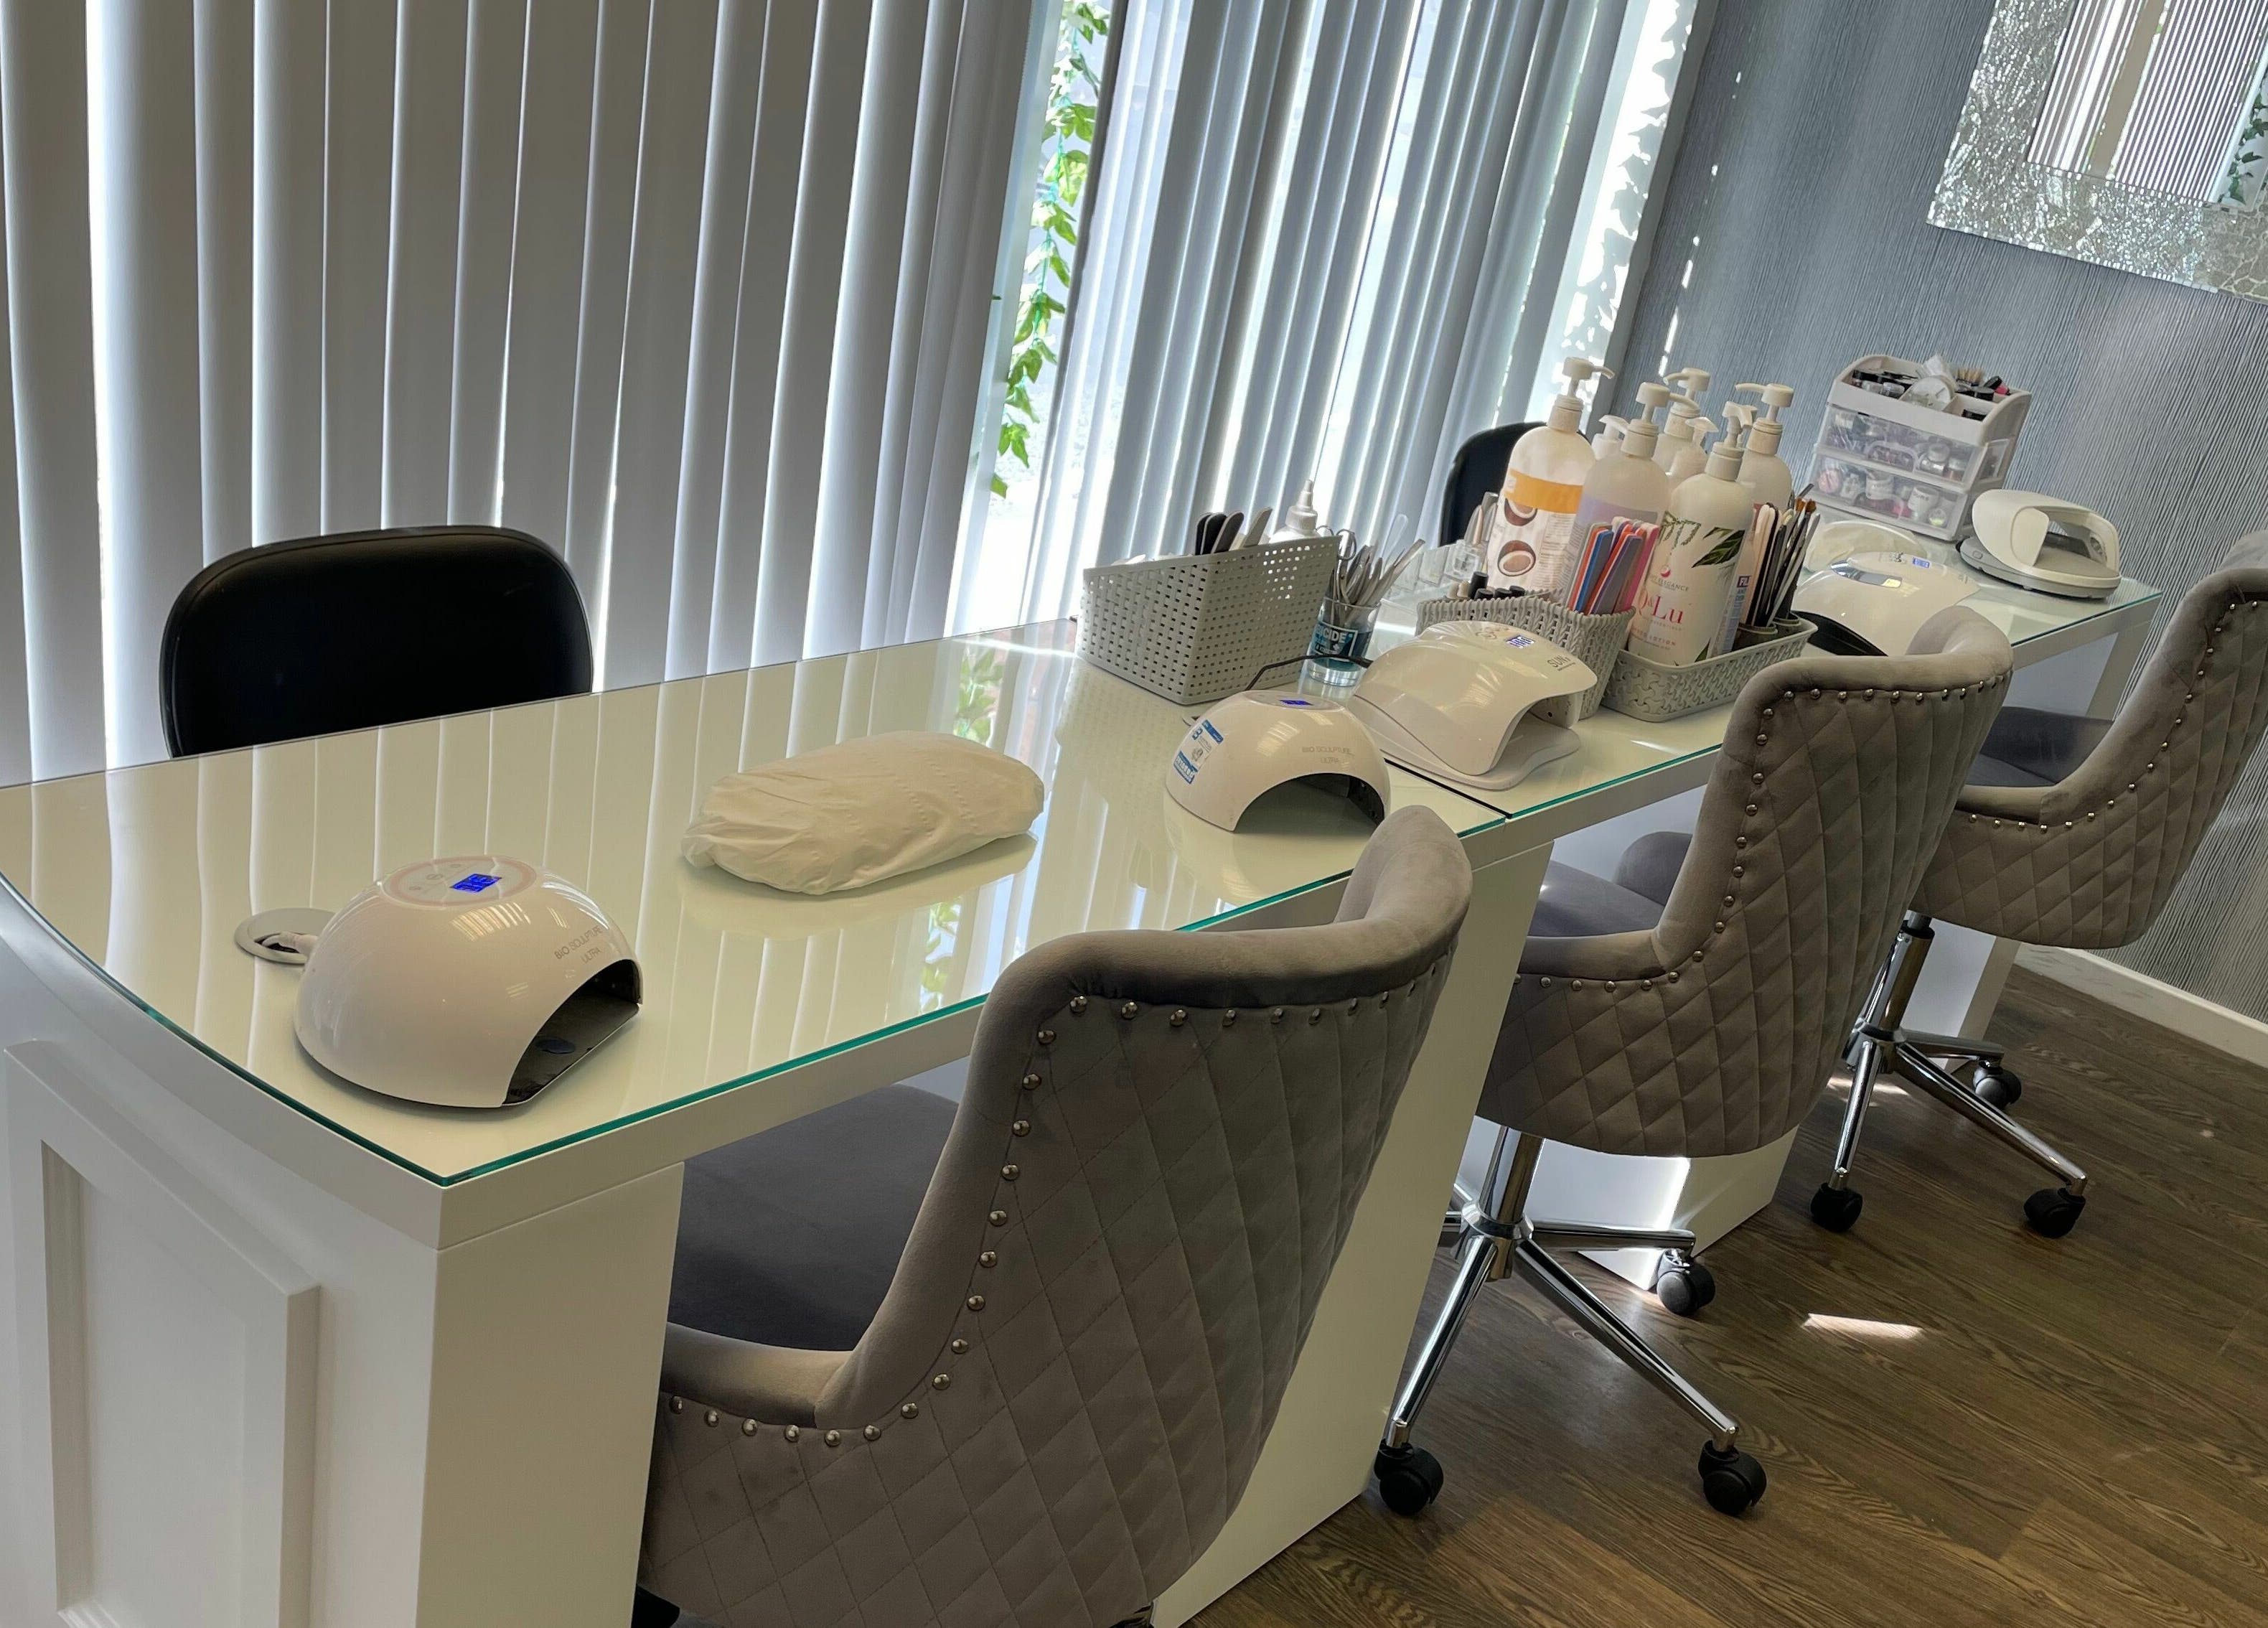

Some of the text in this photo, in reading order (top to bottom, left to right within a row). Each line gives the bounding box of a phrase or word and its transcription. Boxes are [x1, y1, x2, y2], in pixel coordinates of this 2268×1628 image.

[554, 925, 603, 960] BIO SCULPTURE
[580, 948, 603, 963] ULTRA
